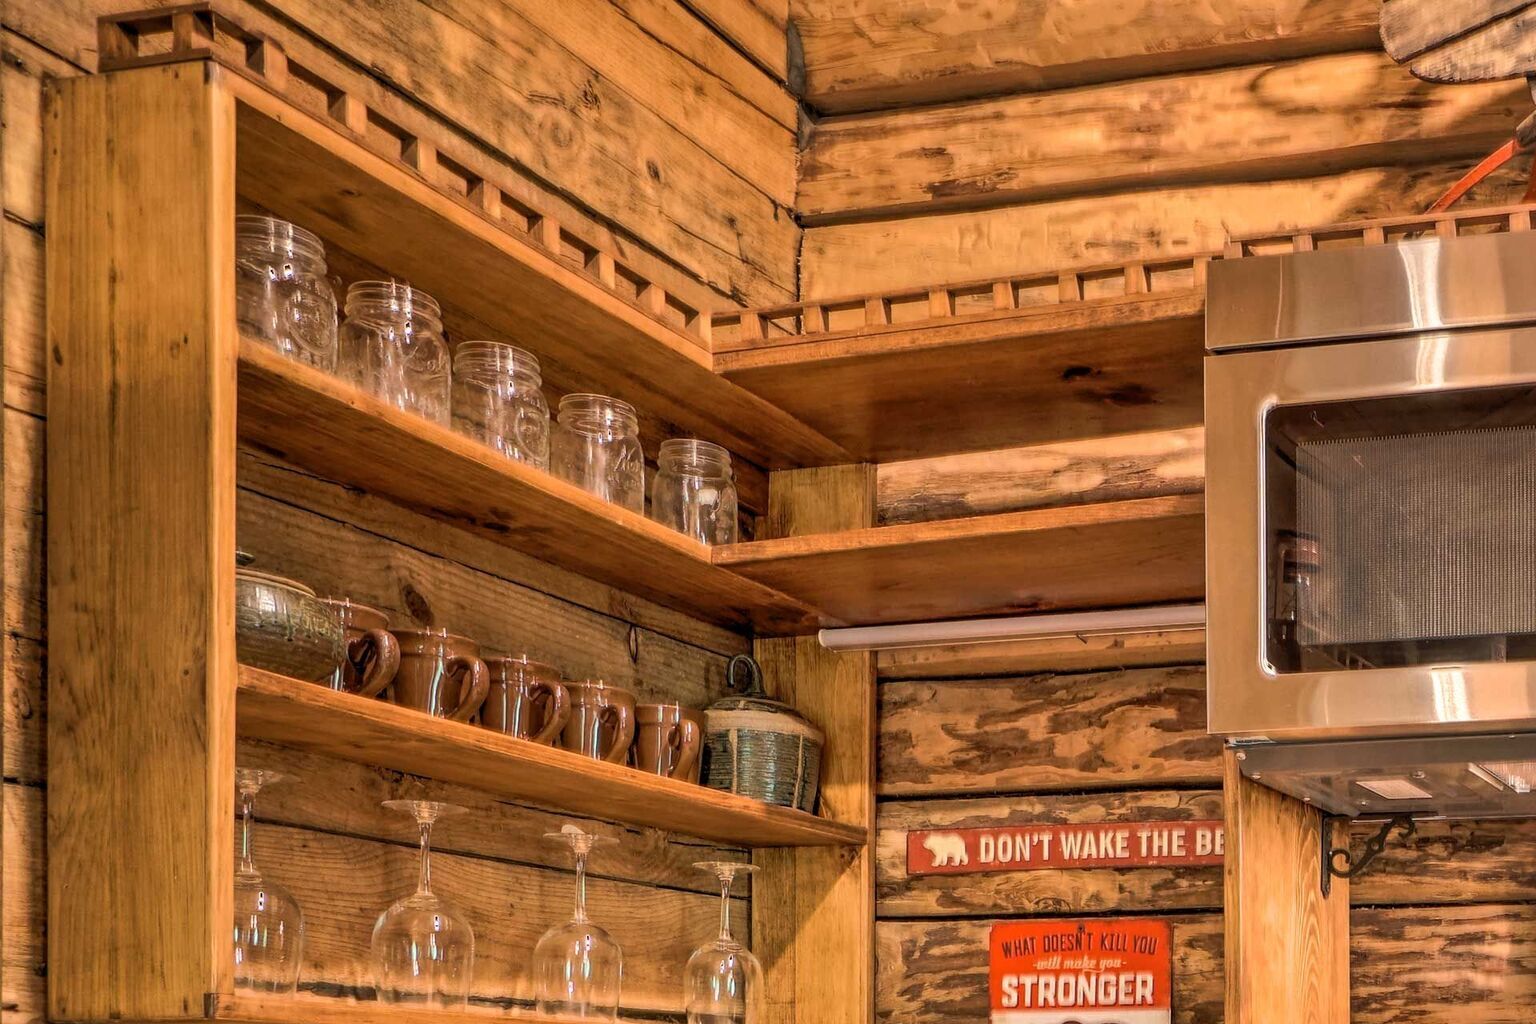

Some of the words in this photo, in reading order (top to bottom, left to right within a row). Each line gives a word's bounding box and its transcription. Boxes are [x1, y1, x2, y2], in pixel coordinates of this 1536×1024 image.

[979, 830, 1053, 863] DON'T
[1060, 828, 1130, 860] WAKE
[1137, 827, 1186, 858] THE
[1002, 936, 1037, 959] WHAT
[1042, 932, 1094, 953] DOESN'T
[1100, 931, 1129, 951] KILL
[1133, 933, 1160, 956] YOU
[1063, 956, 1097, 972] make
[1001, 972, 1154, 1008] STRONGER
